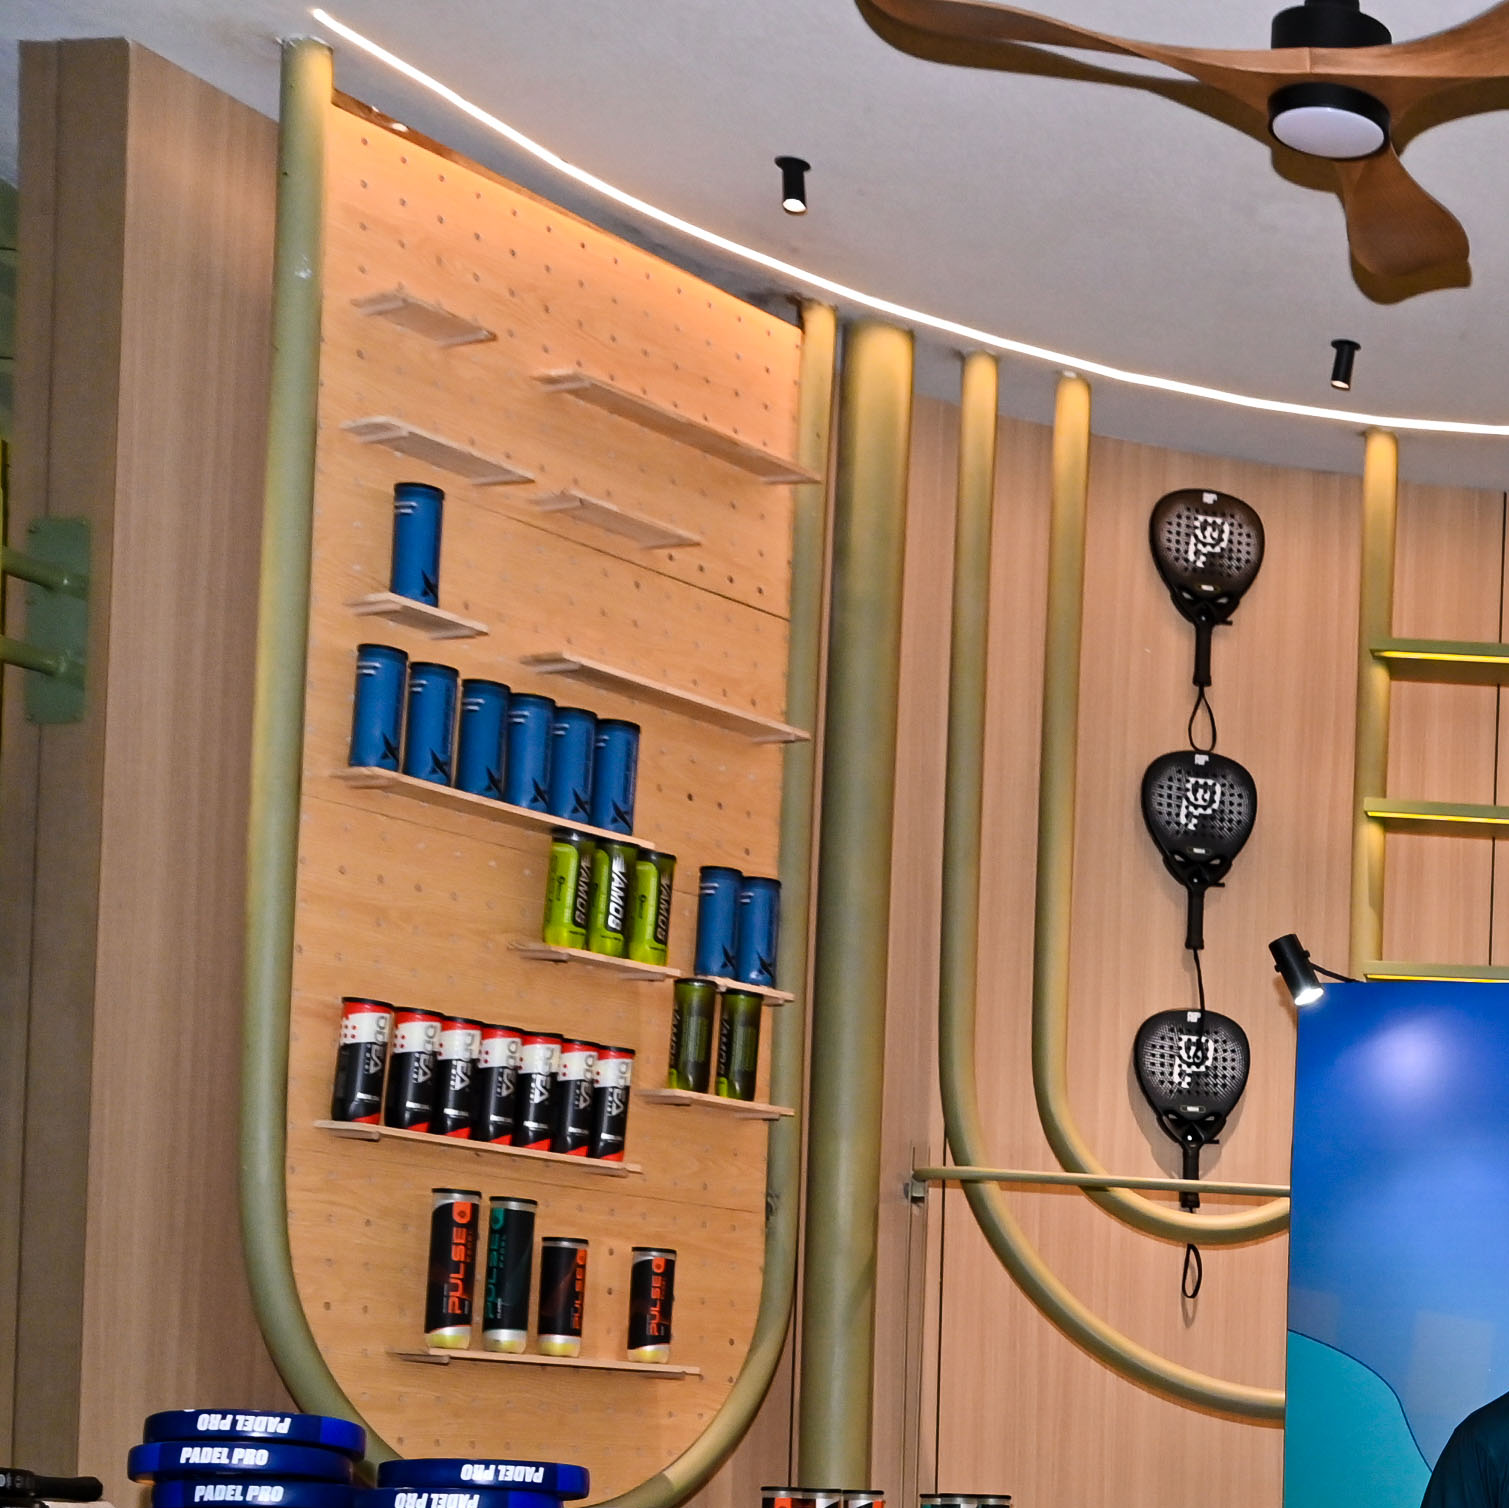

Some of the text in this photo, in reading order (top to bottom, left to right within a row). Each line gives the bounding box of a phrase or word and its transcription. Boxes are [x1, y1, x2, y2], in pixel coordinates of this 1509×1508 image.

[448, 1227, 469, 1313] PULSE
[649, 1275, 662, 1336] PULSE
[197, 1414, 292, 1434] PADEL PRO
[180, 1447, 269, 1465] PADEL PRO
[461, 1464, 544, 1483] PADEL PRO
[195, 1485, 284, 1502] PADEL PRO
